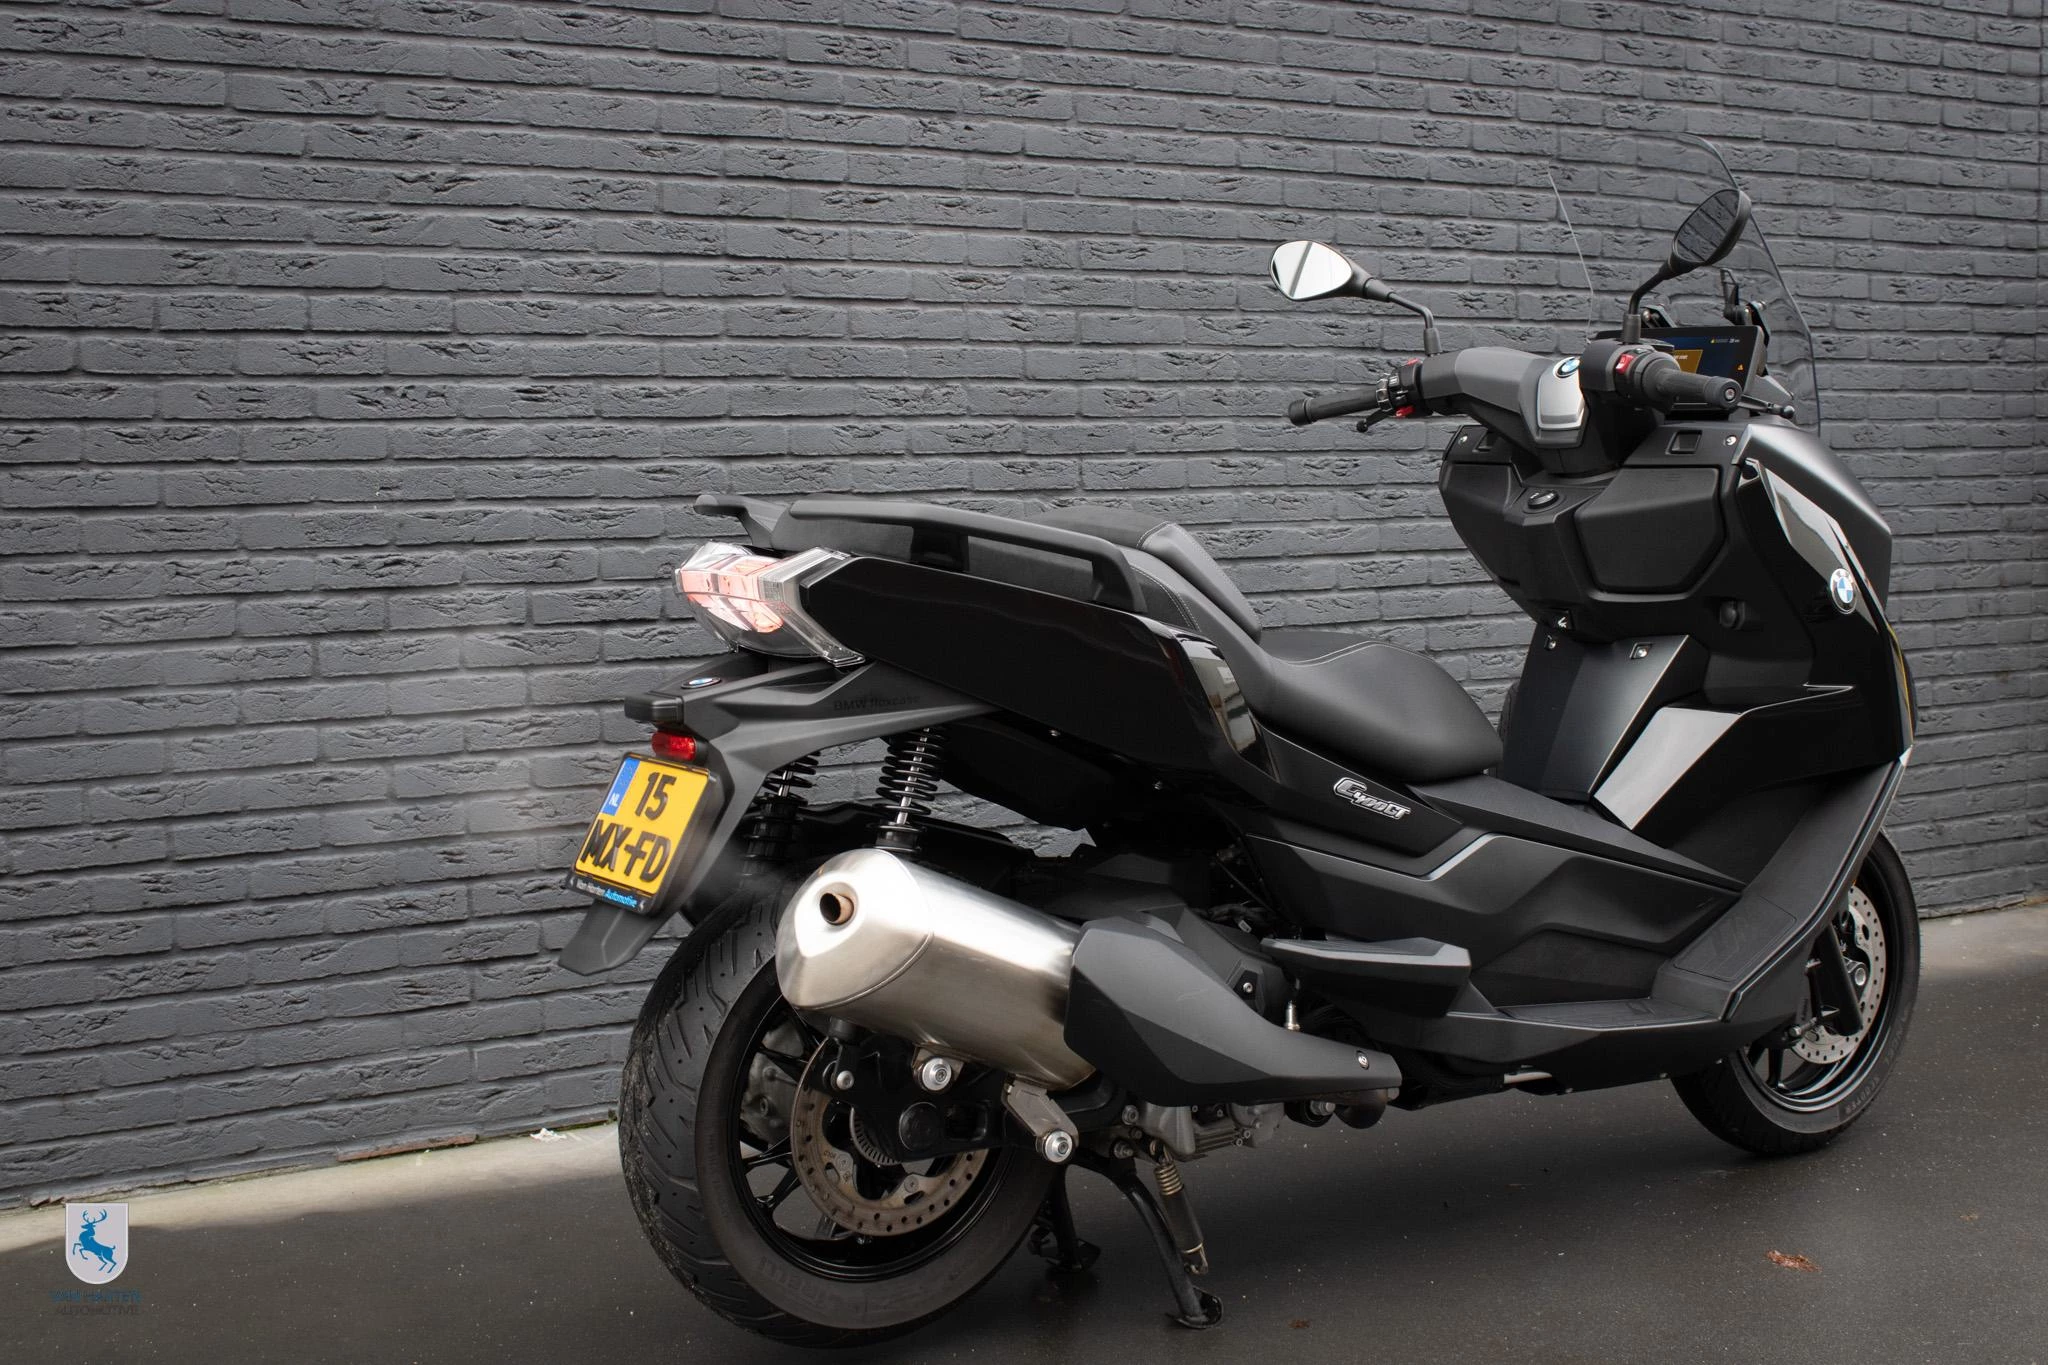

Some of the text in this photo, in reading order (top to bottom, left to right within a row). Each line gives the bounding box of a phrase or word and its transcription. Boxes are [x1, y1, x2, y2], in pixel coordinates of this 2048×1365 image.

[833, 698, 866, 711] BMW
[608, 793, 620, 807] NL
[635, 771, 677, 821] 15
[580, 819, 672, 883] MX-FD
